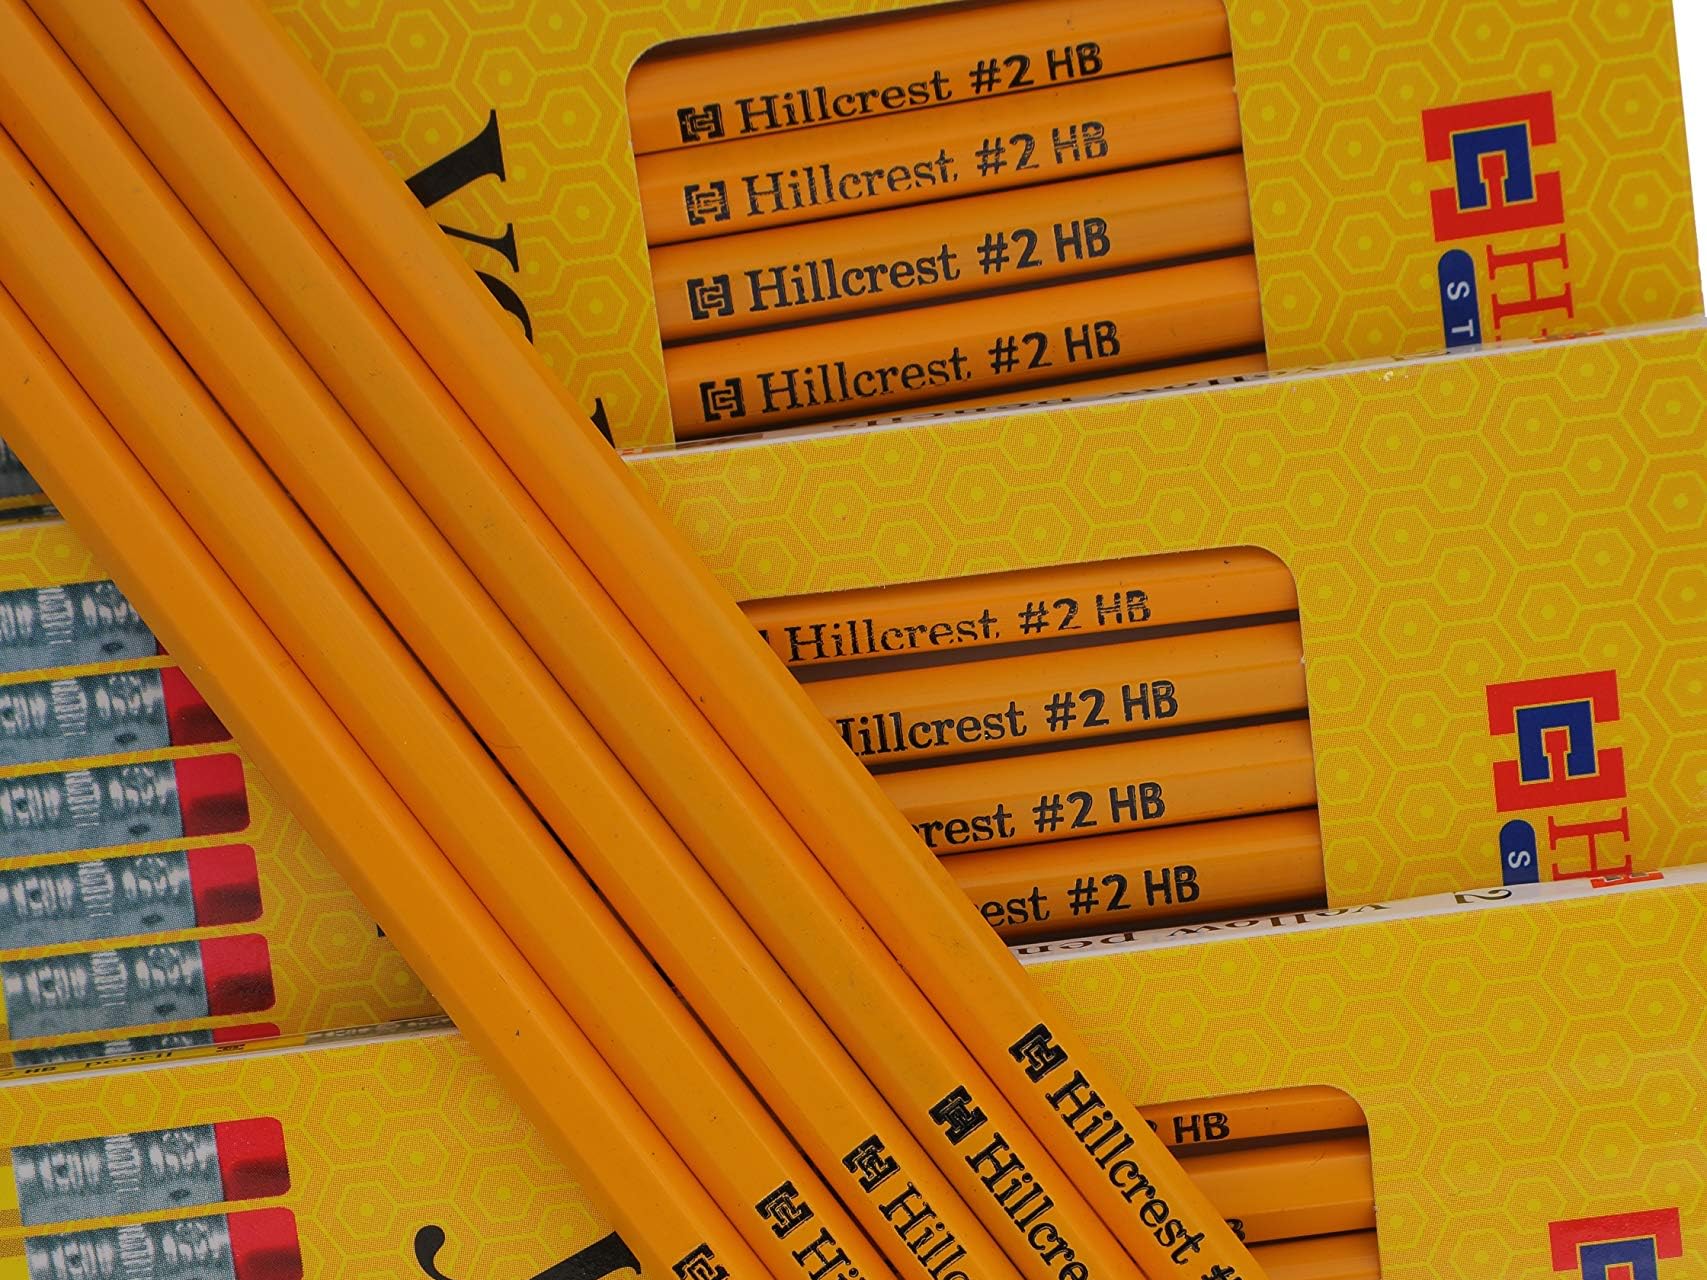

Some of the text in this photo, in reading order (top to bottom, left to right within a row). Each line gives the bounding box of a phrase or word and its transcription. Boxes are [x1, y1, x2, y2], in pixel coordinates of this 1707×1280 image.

[736, 41, 1103, 135] Hillcrest #2 HB
[742, 121, 1109, 217] Hillcrest #2 HB
[744, 217, 1112, 312] Hillcrest #2 HB
[757, 347, 972, 415] Hillcrest
[988, 331, 1053, 374] #2
[1064, 320, 1122, 362] HB
[784, 589, 1152, 663] Hillcrest #2 HB
[1044, 688, 1110, 733] #2
[1122, 679, 1179, 722] HB
[910, 781, 1166, 849] rest #2 HB
[1067, 873, 1134, 917] #2
[1144, 865, 1201, 907] HB
[1046, 1071, 1206, 1266] Hillcrest
[1172, 1112, 1230, 1143] HB
